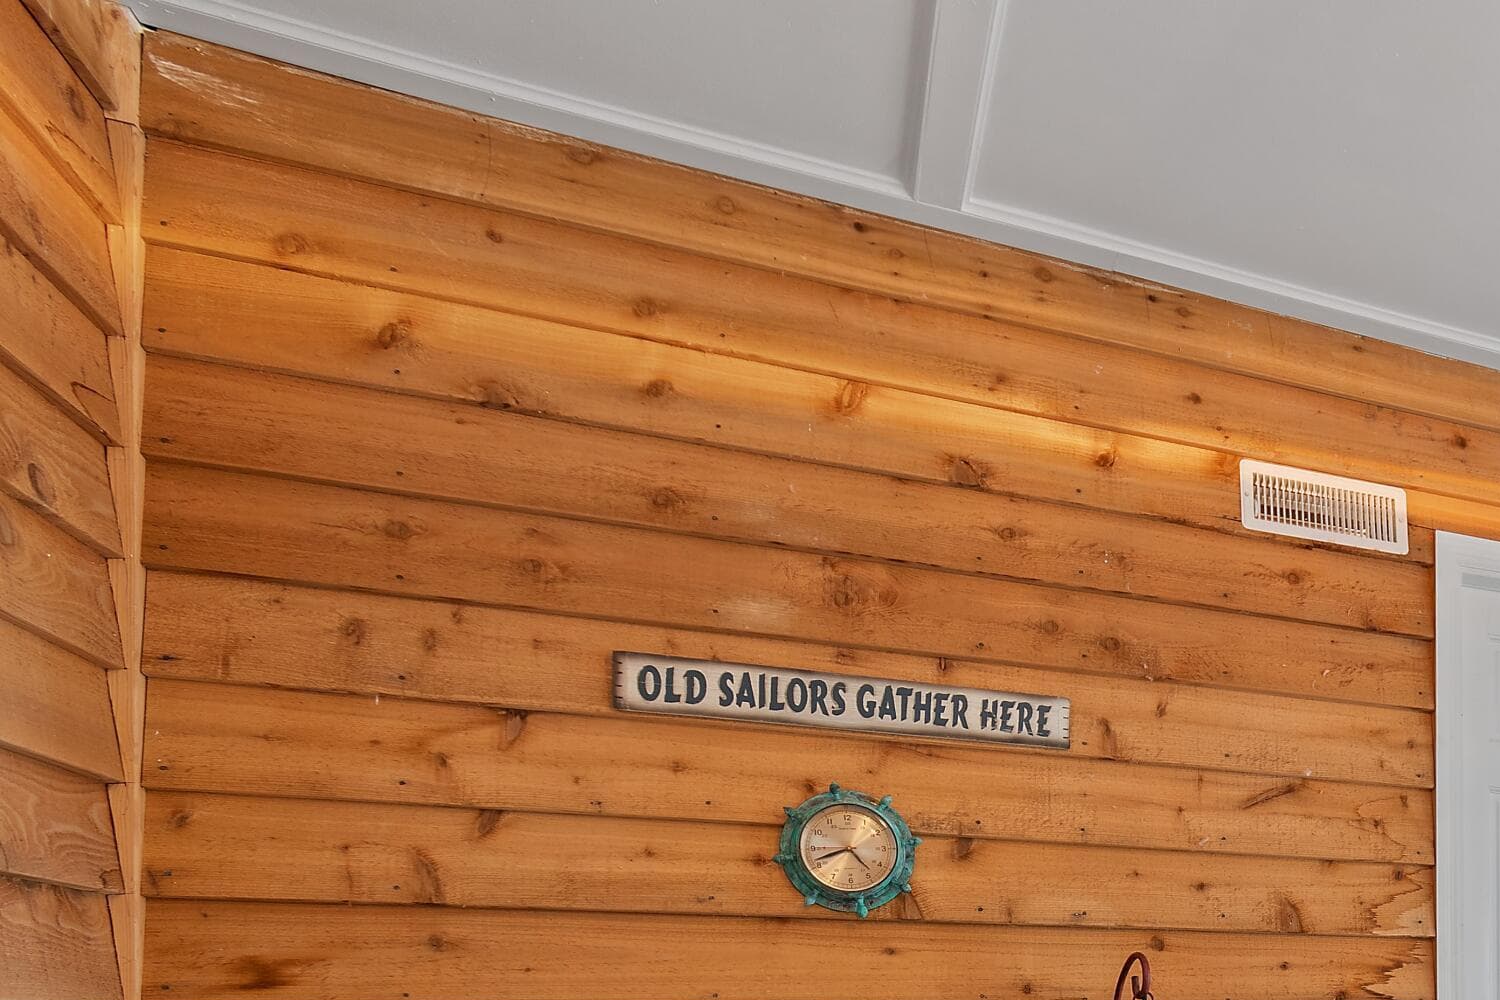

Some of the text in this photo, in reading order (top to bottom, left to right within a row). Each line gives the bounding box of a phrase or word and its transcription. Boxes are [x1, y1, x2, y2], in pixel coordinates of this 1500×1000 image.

[637, 664, 1052, 738] OLD SAILORS GATHER HERE
